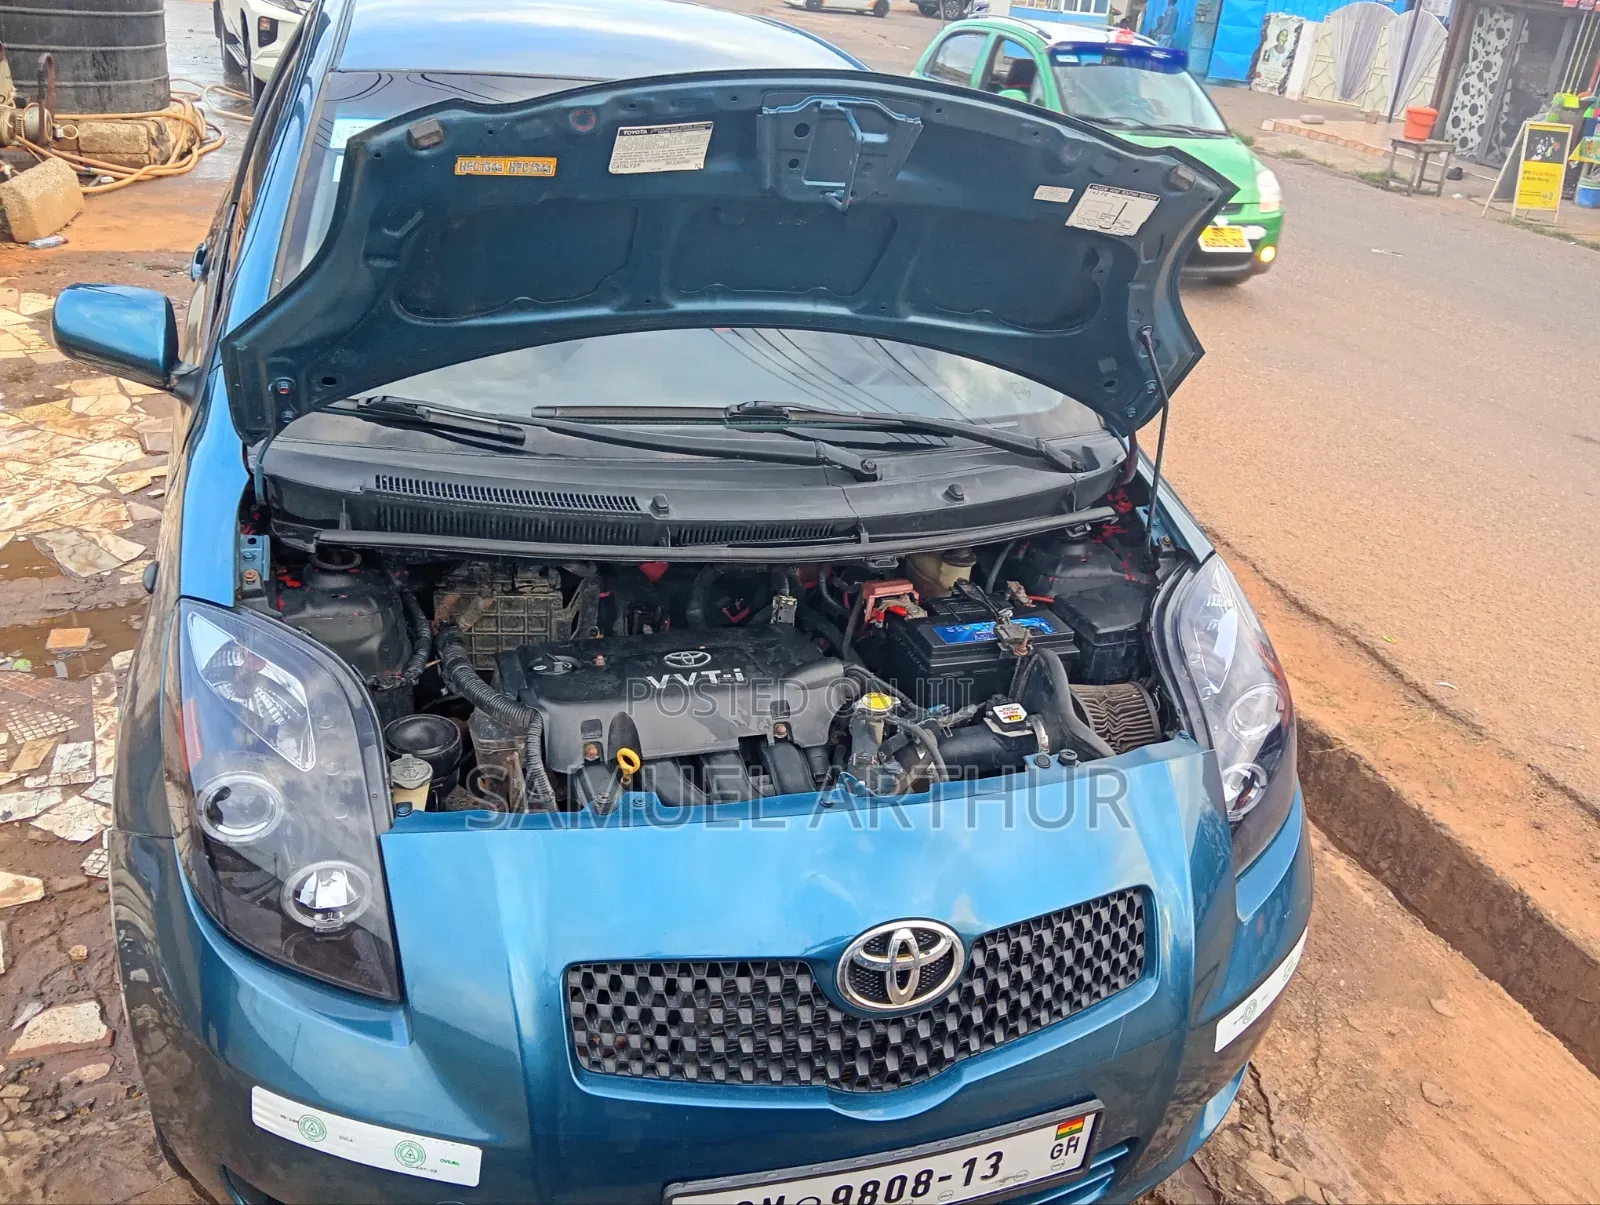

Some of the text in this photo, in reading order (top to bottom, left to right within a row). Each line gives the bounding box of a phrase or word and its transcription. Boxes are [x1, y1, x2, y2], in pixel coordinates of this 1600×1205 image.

[646, 668, 744, 689] VVT-i
[1050, 1137, 1080, 1160] GH
[832, 1151, 1004, 1204] 9808-13
